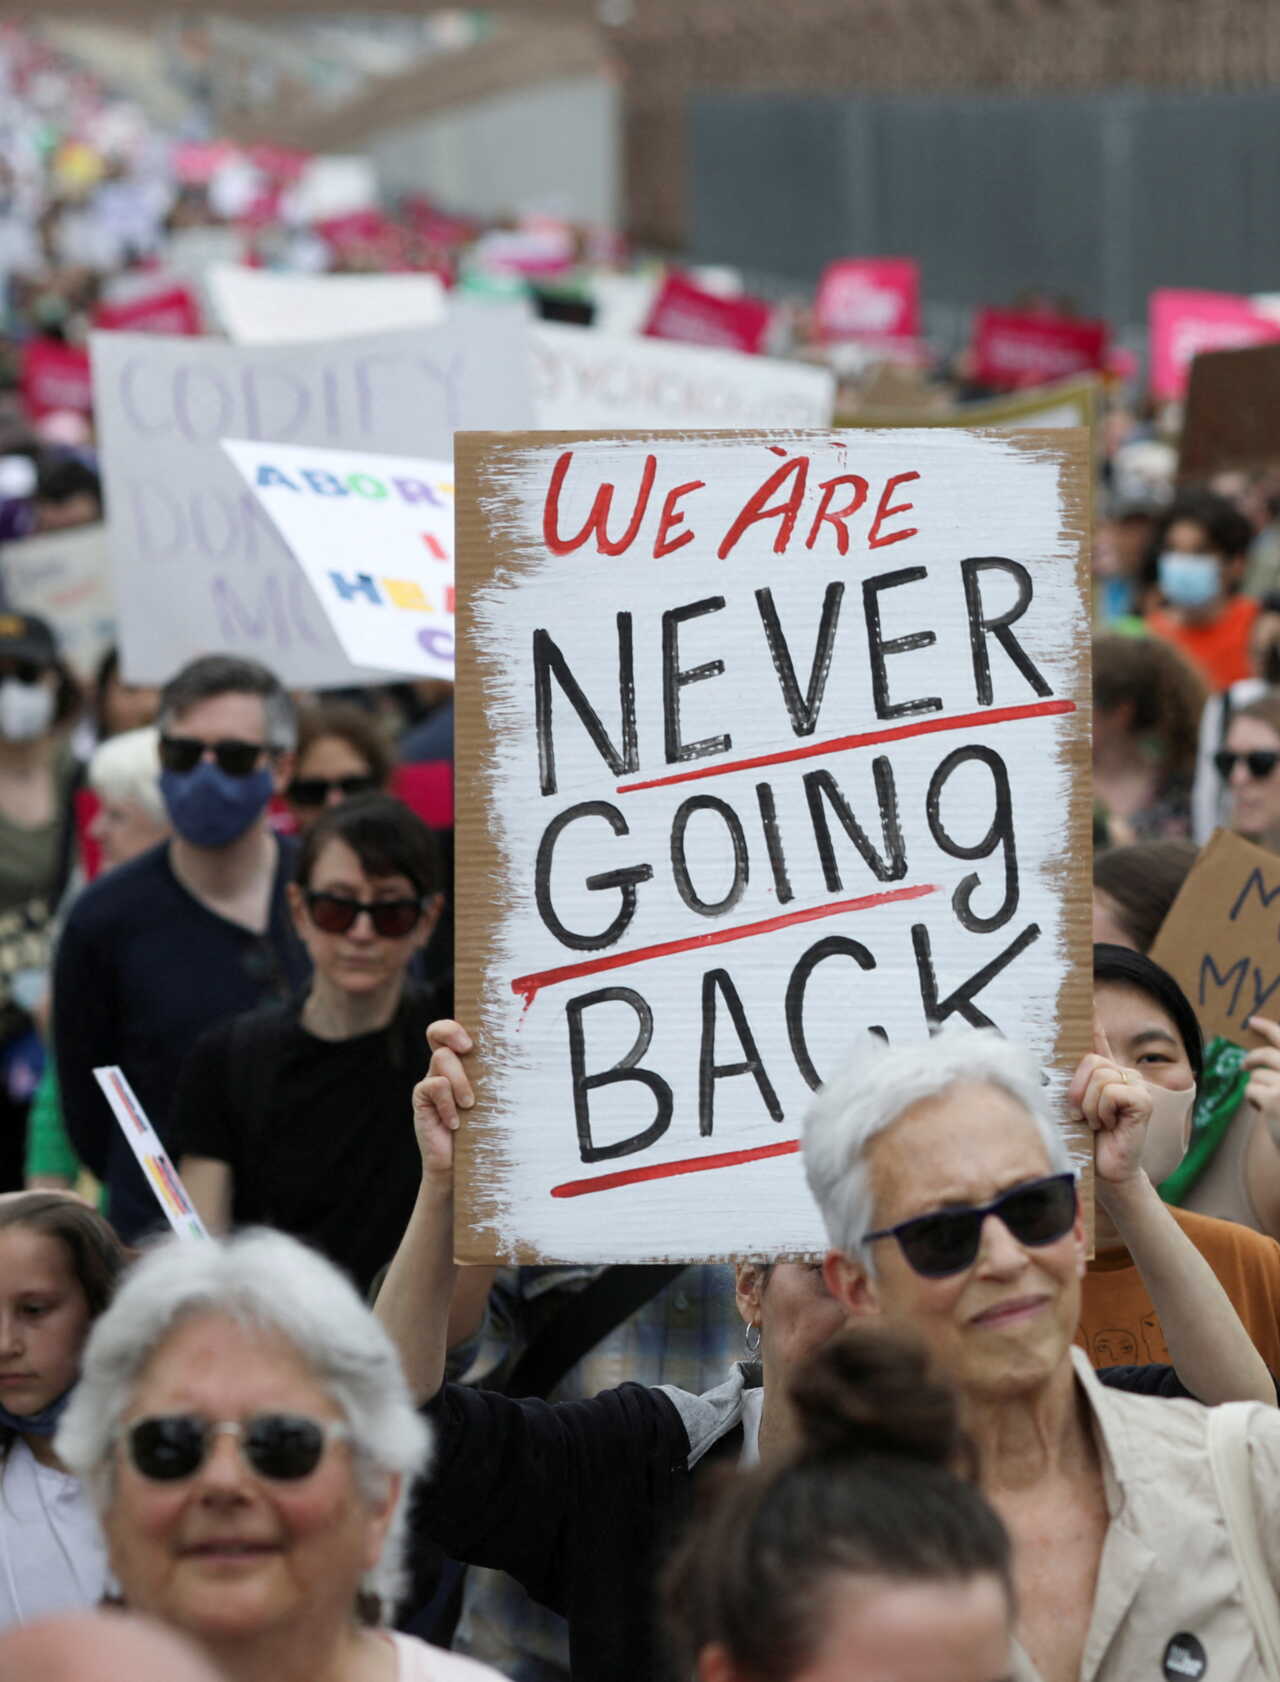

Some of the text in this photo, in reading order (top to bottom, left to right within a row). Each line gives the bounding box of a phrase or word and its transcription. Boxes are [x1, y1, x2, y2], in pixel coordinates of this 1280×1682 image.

[543, 452, 922, 559] WE ARE
[533, 556, 1053, 796] NEVER
[566, 922, 1047, 1164] BACK
